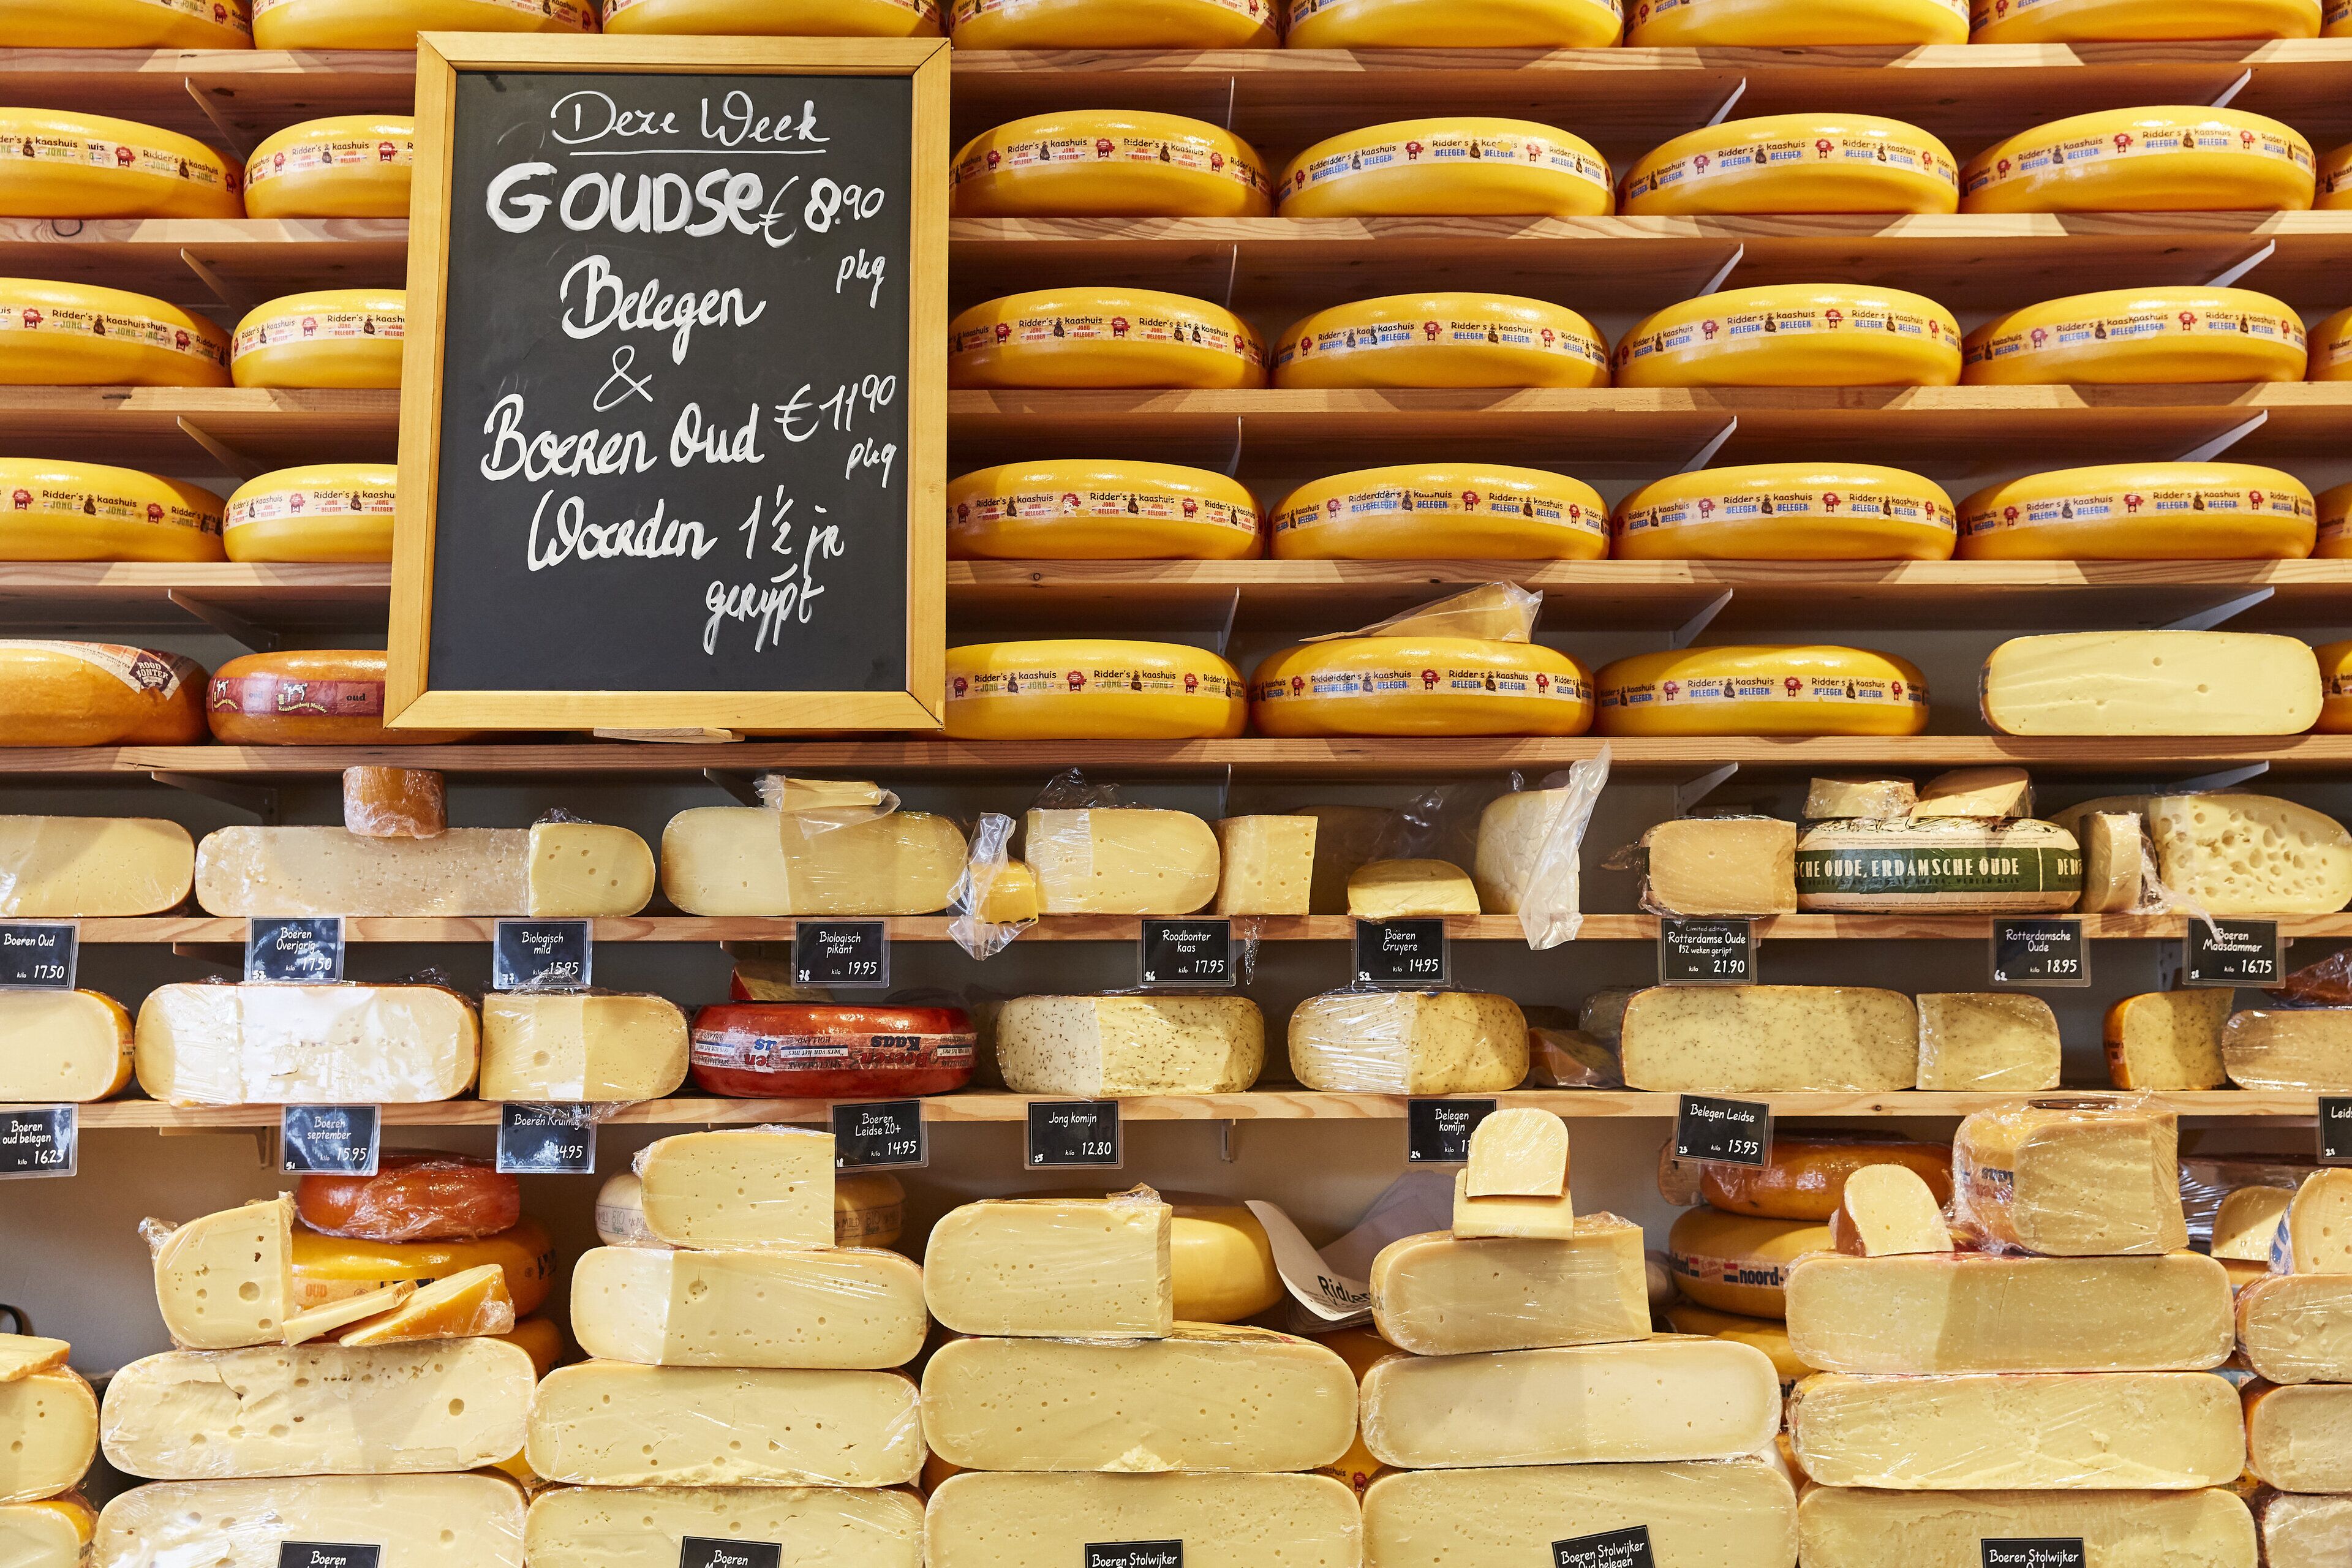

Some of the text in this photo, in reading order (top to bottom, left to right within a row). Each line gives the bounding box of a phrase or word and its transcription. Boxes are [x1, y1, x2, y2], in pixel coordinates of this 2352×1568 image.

[551, 91, 831, 147] Deze Week
[292, 141, 369, 155] Ridder's kaashuis
[1008, 138, 1087, 153] Ridder's kaashuis
[2064, 137, 2103, 149] kaashuis
[1362, 145, 1396, 156] kaashuis
[1771, 151, 1801, 160] BELEGEN
[189, 160, 219, 176] kaashuis
[837, 249, 886, 309] pkg
[560, 254, 766, 366] Belegen
[1776, 310, 1815, 320] kaashuis
[52, 309, 145, 328] Ridder's kaashuis
[327, 314, 363, 323] Ridder's
[1019, 316, 1102, 328] Ridder's kaashuis
[2209, 322, 2237, 330] BELEGEN
[1454, 331, 1483, 340] BELEGEN
[593, 344, 654, 412] &
[670, 402, 764, 468] Oud
[845, 439, 897, 488] pkg
[42, 490, 137, 508] Ridder's kaashuis
[1090, 492, 1175, 503] Ridder's kaashuis
[1774, 492, 1812, 502] kaashuis
[1094, 669, 1176, 680] Ridder's kaashuis
[1374, 670, 1411, 680] kaashuis
[1736, 676, 1774, 685] kaashuis
[1027, 681, 1047, 690] JONG
[1452, 680, 1482, 689] BELEGEN
[347, 693, 366, 701] oud
[1872, 859, 1973, 877] ERDAMSCHE
[1979, 858, 2019, 876] OUDE
[4, 933, 55, 947] Boeren Oud
[281, 927, 312, 939] Boeren
[521, 931, 564, 948] Biologisch
[820, 931, 861, 948] Biologisch
[1162, 929, 1212, 941] Roodbonter
[1384, 929, 1415, 940] Boeren
[1668, 931, 1746, 944] Rotterdamse Oude
[2005, 929, 2071, 941] Rotterdamsche
[2217, 928, 2248, 941] Boeren
[276, 938, 315, 954] Overjarig
[533, 944, 551, 954] mild
[827, 944, 853, 959] pikant
[1177, 941, 1196, 952] kaas
[1382, 940, 1418, 956] Gruyere
[1711, 946, 1732, 957] gerijpt
[2027, 940, 2049, 952] Oude
[2203, 938, 2262, 952] Maasdammer
[302, 957, 332, 971] 17.50
[848, 962, 877, 975] 19.95
[1195, 960, 1224, 973] 17.95
[1409, 959, 1439, 972] 14.95
[1713, 960, 1745, 973] 21.90
[2046, 959, 2078, 973] 18.95
[2242, 959, 2272, 974] 16.75
[34, 965, 64, 979] 17.50
[871, 1035, 921, 1050] Kaas
[859, 1050, 929, 1068] Boeren
[862, 1112, 894, 1125] Boeren
[1435, 1109, 1469, 1125] Belegen
[1690, 1104, 1755, 1123] Belegen Leidse
[2331, 1106, 2352, 1118] Leid
[11, 1120, 43, 1133] Boeren
[314, 1116, 345, 1129] Boeren
[514, 1114, 545, 1126] Boeren
[1049, 1112, 1097, 1128] Jong komijn
[855, 1123, 901, 1137] Leidse 20+
[1439, 1122, 1465, 1136] komijn
[2, 1132, 51, 1147] oud belegen
[307, 1131, 352, 1144] september
[336, 1147, 368, 1161] 15.95
[888, 1140, 917, 1156] 14.95
[1082, 1142, 1112, 1156] 12.80
[1728, 1139, 1758, 1155] 15.95
[34, 1149, 64, 1164] 16.25
[310, 1550, 347, 1566] Boeren
[713, 1550, 748, 1566] Boeren
[1561, 1540, 1645, 1564] Boeren Stolwijker
[1989, 1548, 2079, 1567] Boeren Stolwijker
[1091, 1552, 1177, 1568] Boeren Stolwijker
[1599, 1557, 1633, 1568] belegen
